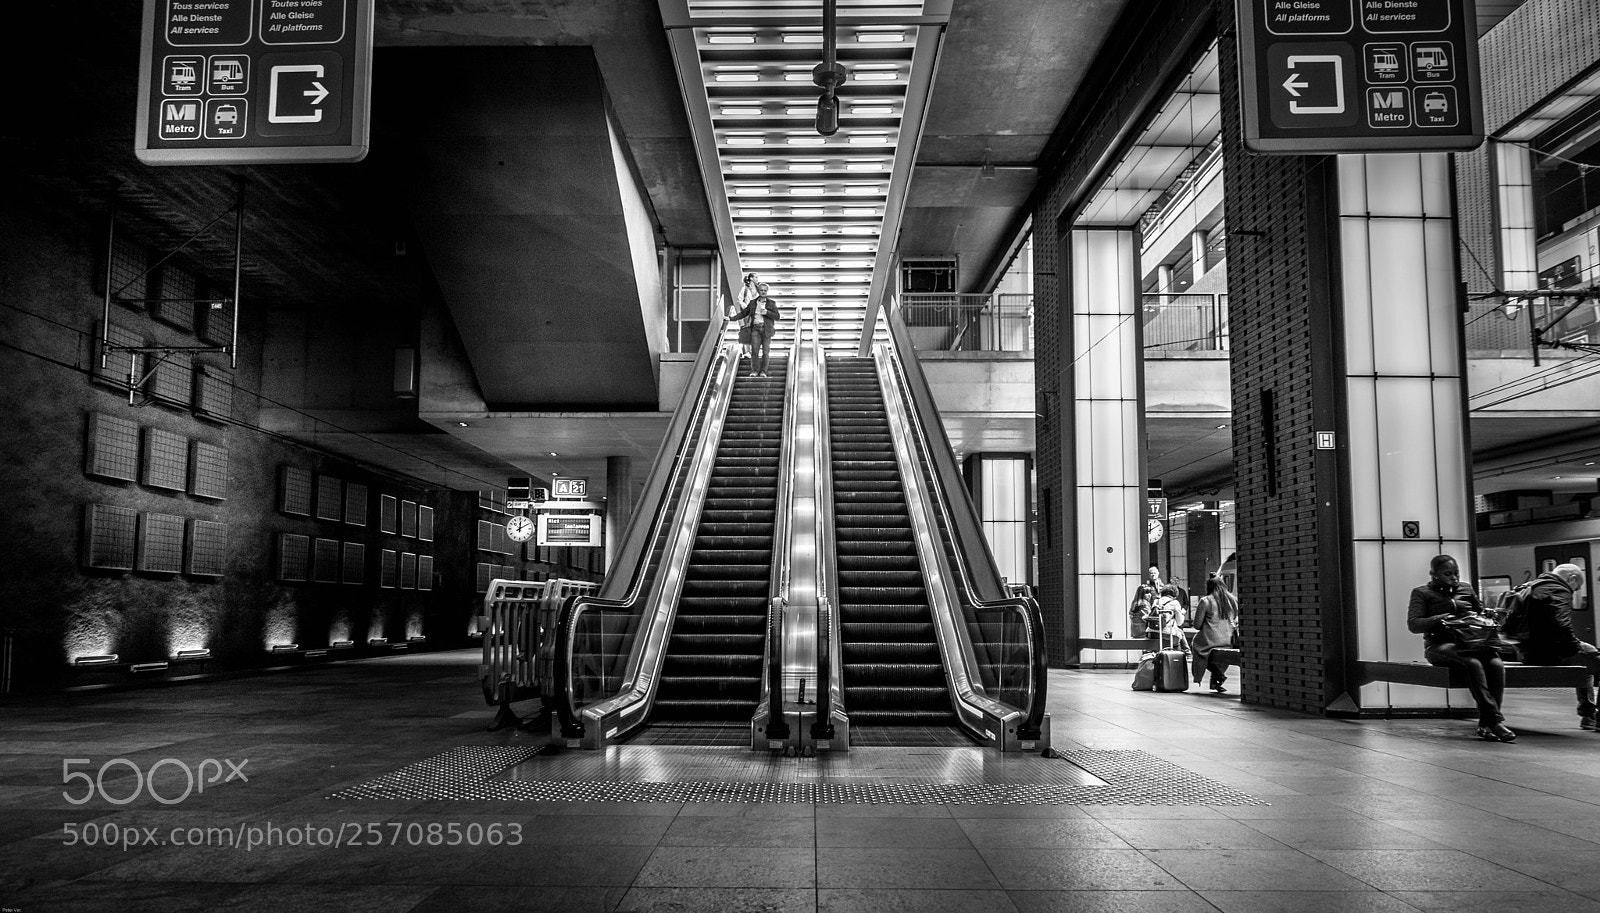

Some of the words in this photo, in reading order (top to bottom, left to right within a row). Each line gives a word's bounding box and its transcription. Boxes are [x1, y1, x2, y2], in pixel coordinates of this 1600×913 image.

[172, 2, 193, 10] Tous
[194, 2, 230, 10] services
[1275, 1, 1292, 9] Alle
[1293, 1, 1321, 9] Gleise
[1365, 1, 1383, 9] Alle
[1384, 0, 1418, 8] Dienste
[171, 14, 189, 22] Alle
[190, 13, 223, 21] Dienste
[269, 12, 287, 20] Alle
[288, 11, 315, 19] Gleise
[1275, 13, 1288, 22] All
[1287, 13, 1331, 23] platforms
[1365, 13, 1379, 21] All
[1379, 12, 1417, 21] services
[170, 26, 183, 34] All
[183, 26, 220, 34] services
[268, 24, 282, 32] All
[281, 23, 324, 33] platforms
[1378, 72, 1396, 80] Tram
[1426, 71, 1441, 79] Bus
[221, 83, 235, 91] Bus
[1374, 112, 1405, 122] Metro
[1429, 115, 1445, 123] Taxi
[165, 124, 195, 134] Metro
[218, 127, 233, 135] Taxi
[558, 483, 568, 493] A
[572, 484, 584, 493] 21
[1150, 504, 1161, 514] 17
